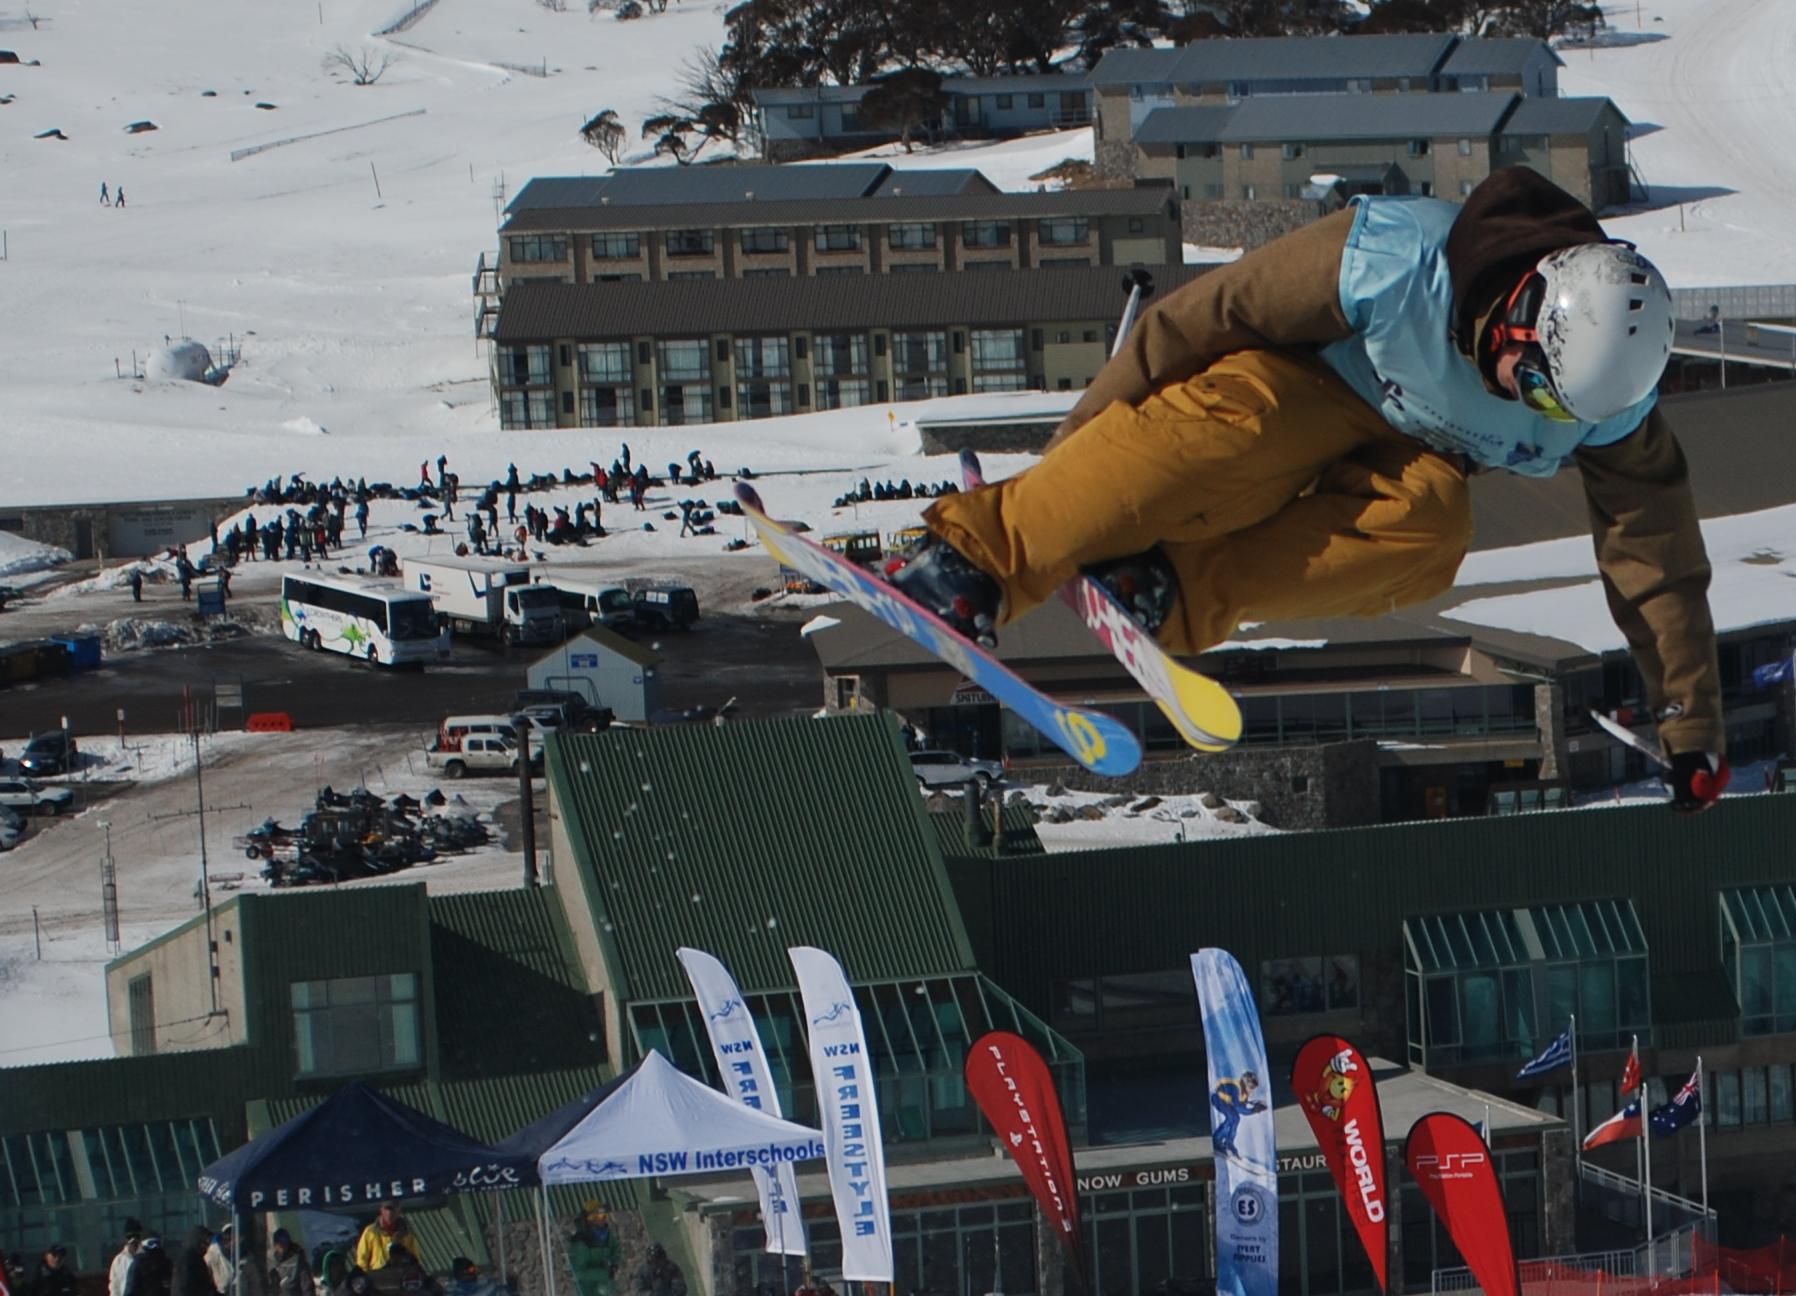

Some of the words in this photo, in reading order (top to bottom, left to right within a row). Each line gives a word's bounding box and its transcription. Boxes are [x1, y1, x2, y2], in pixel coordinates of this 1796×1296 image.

[639, 1151, 688, 1174] NSW
[696, 1140, 825, 1169] Interschools
[1417, 1153, 1484, 1170] PSP
[1136, 1168, 1189, 1185] GUMS
[1344, 1119, 1384, 1223] WORLD
[251, 1178, 426, 1208] PERISHER
[1238, 1199, 1256, 1216] ES
